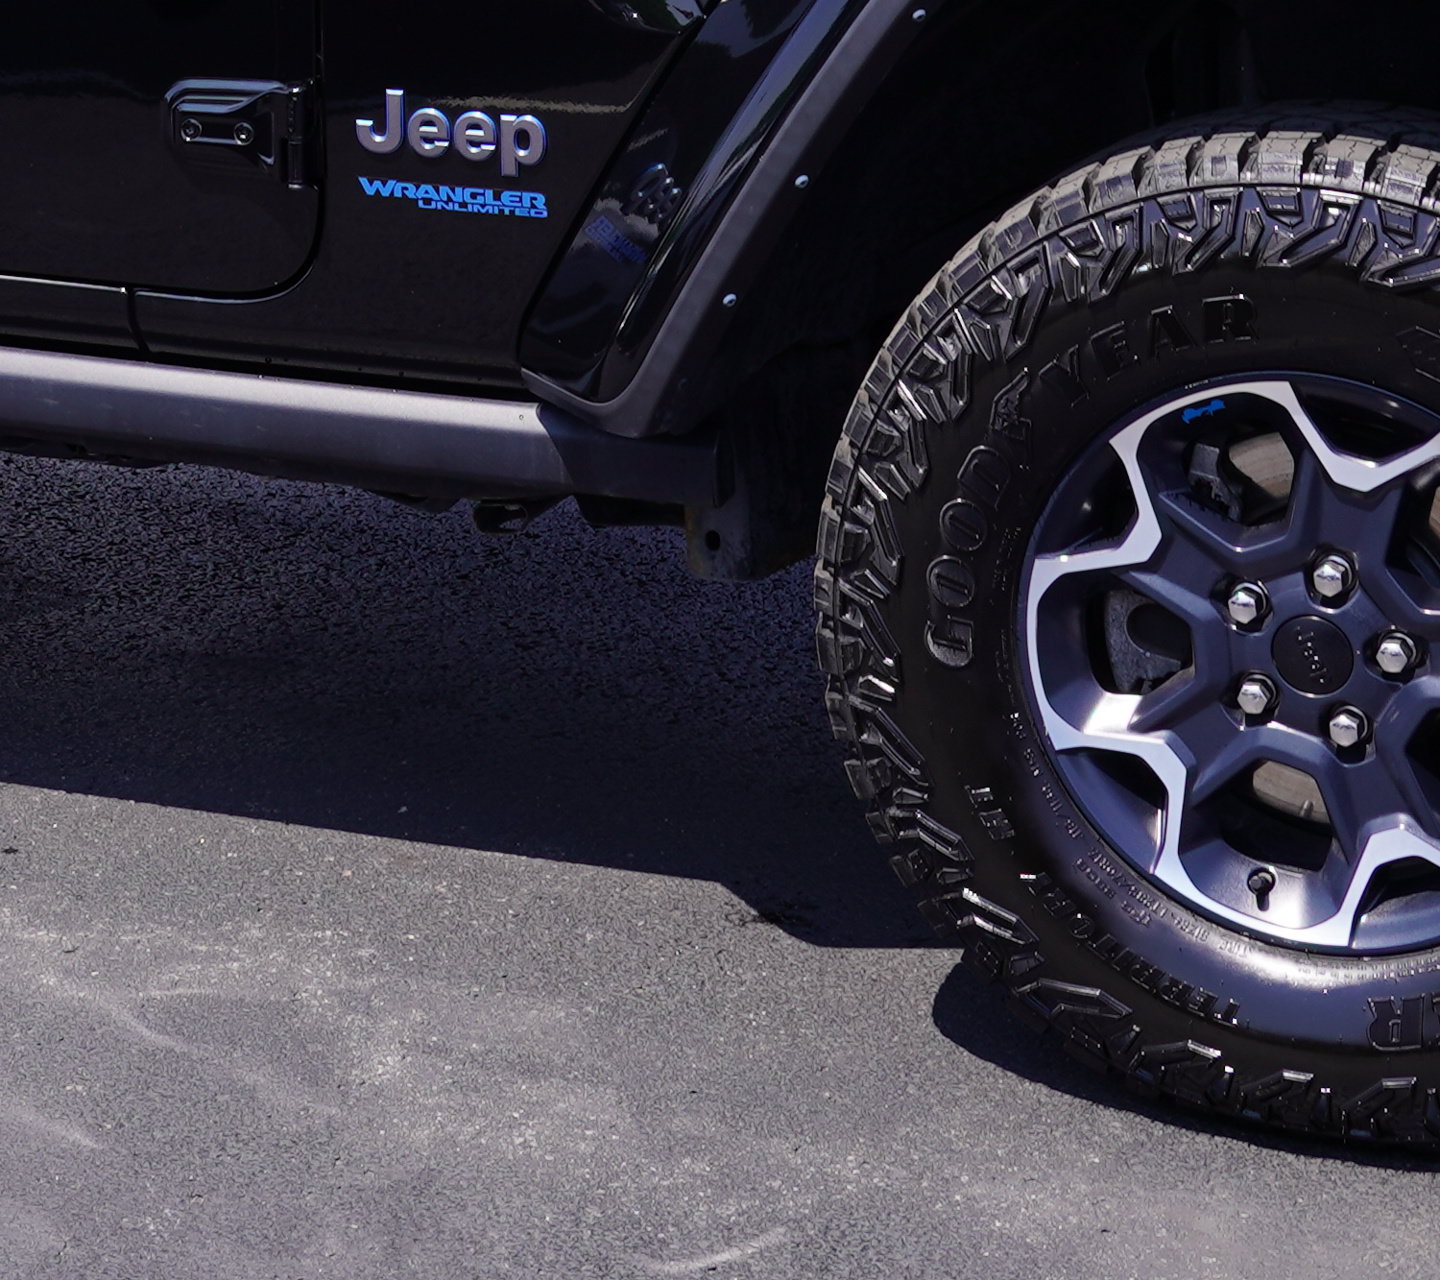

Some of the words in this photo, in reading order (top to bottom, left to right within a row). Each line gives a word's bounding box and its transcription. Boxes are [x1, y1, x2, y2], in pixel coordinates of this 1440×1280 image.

[355, 88, 548, 178] Jeep
[358, 176, 547, 210] WRANGLER
[417, 199, 548, 218] UNLIMITED
[924, 292, 1262, 669] GOODYEAR
[1018, 871, 1241, 1029] TERRITORY
